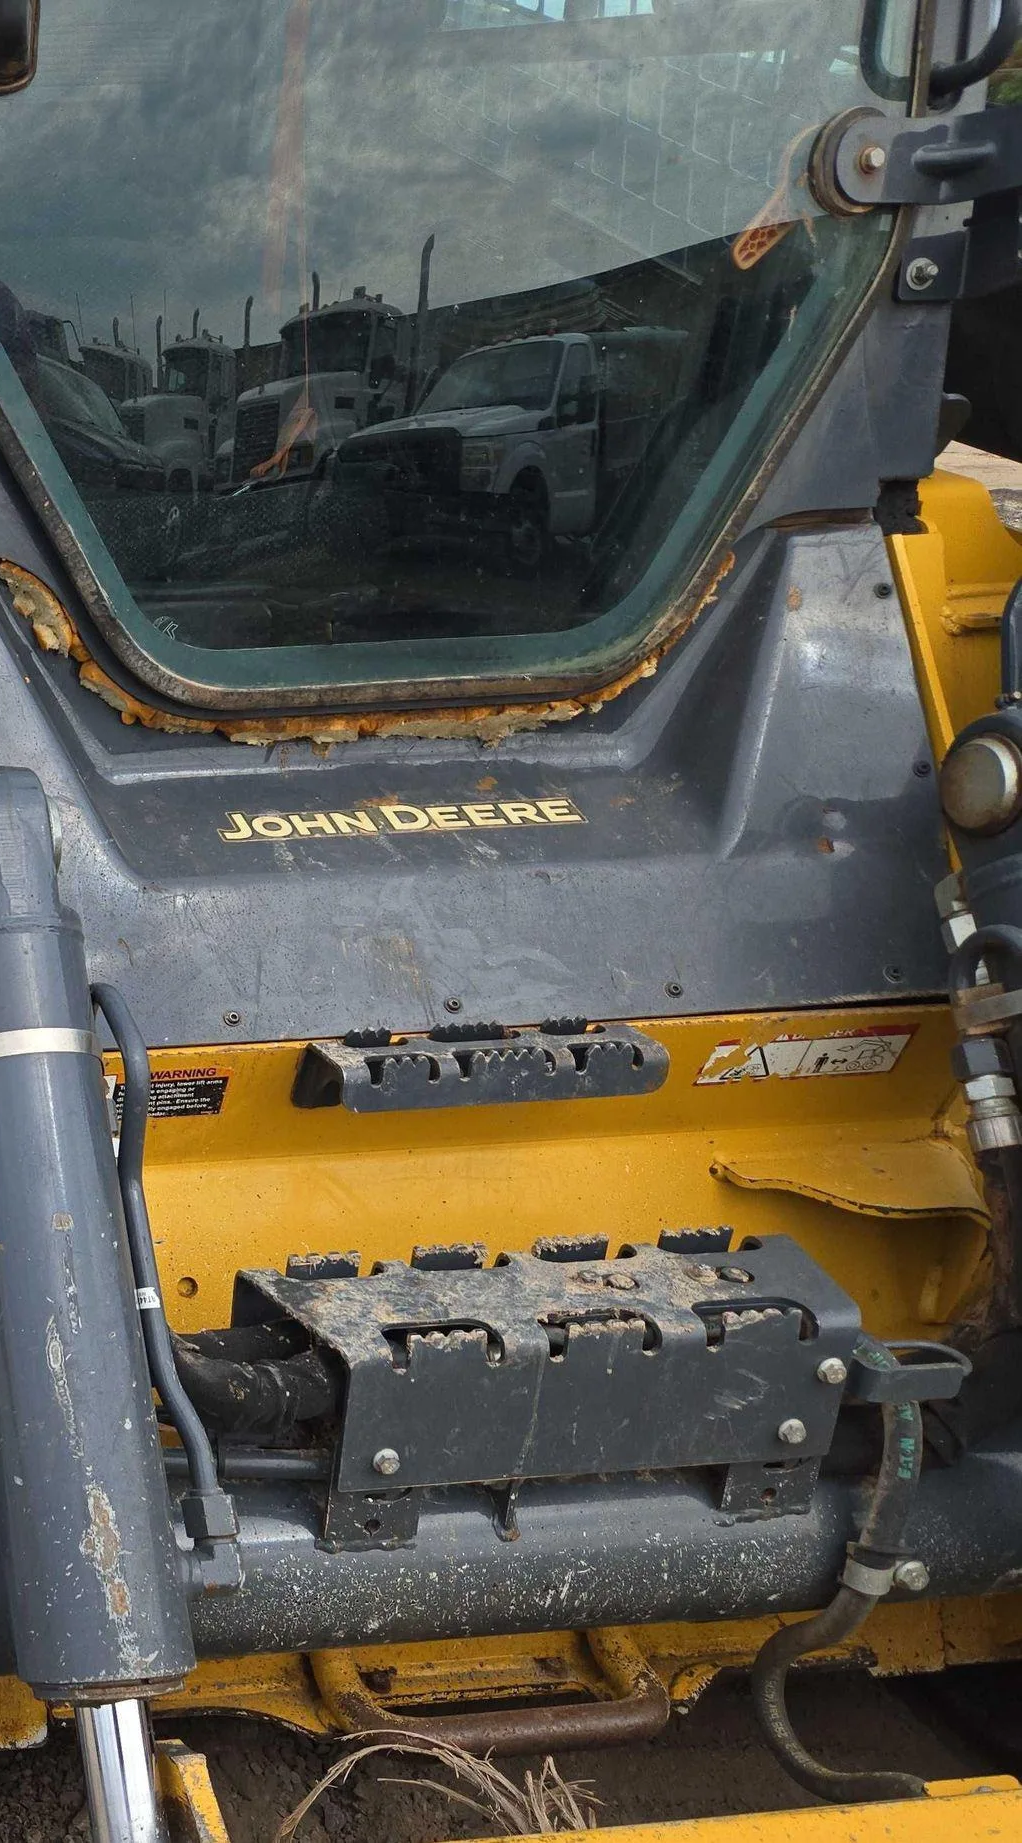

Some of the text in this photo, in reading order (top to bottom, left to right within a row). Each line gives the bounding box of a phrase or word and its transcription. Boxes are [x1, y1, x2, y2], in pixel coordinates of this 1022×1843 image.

[223, 798, 582, 841] JOHN DEERE
[150, 1067, 217, 1080] WARNING
